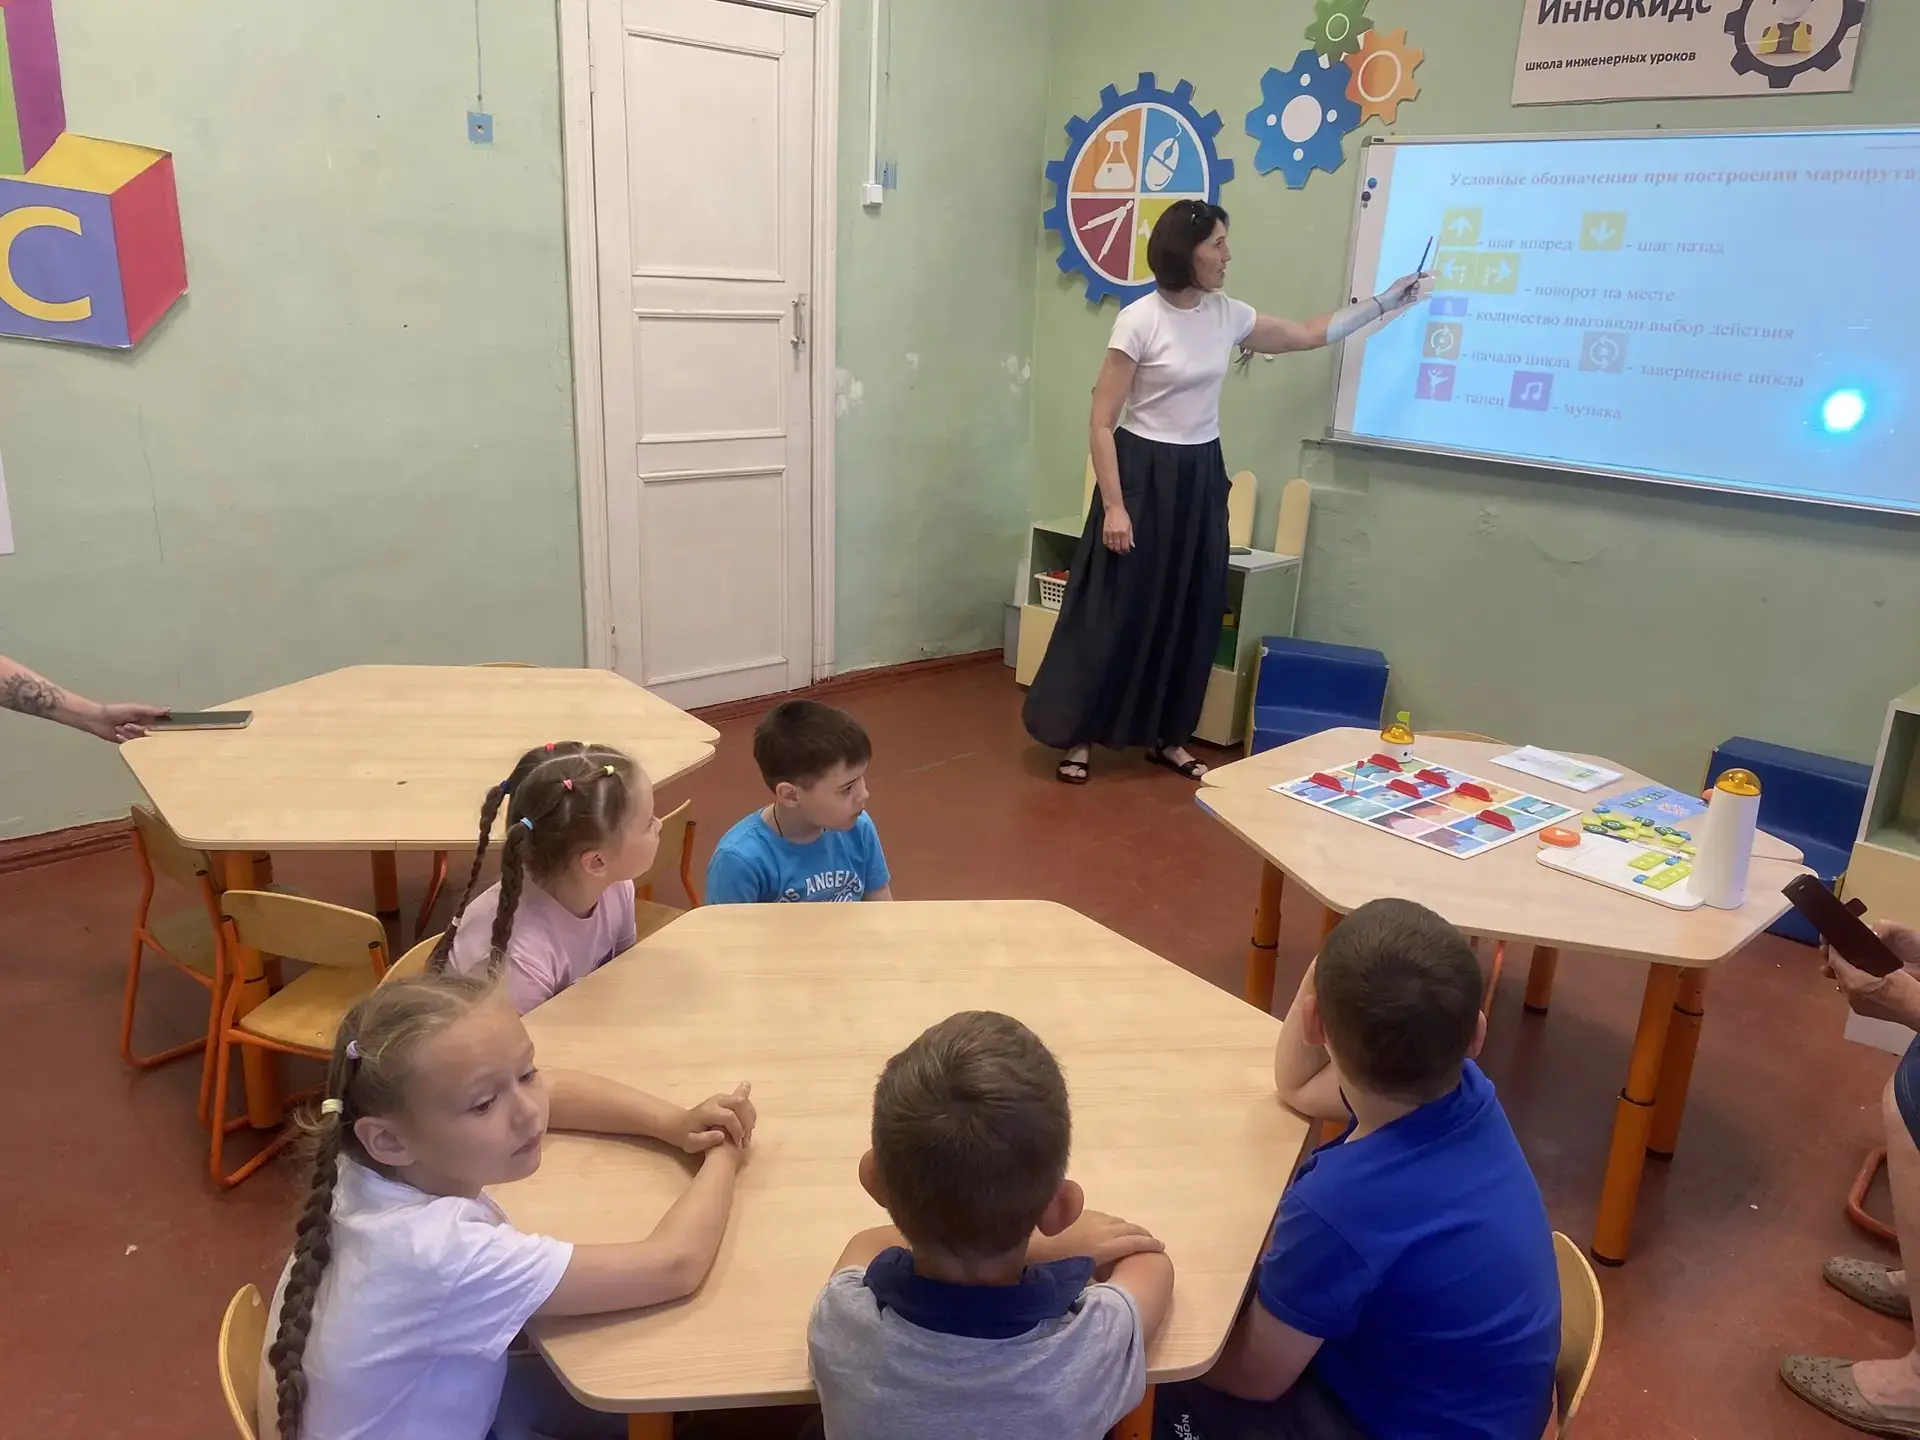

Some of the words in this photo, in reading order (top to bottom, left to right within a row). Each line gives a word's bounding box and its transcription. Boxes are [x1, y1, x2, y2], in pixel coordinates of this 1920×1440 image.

[1525, 59, 1563, 71] школа
[1565, 53, 1647, 69] инженерных
[1650, 51, 1697, 65] уроков
[1450, 172, 1527, 187] Условные
[1531, 170, 1637, 186] обозначения
[1644, 170, 1679, 186] при
[1684, 168, 1798, 186] построении
[1805, 167, 1916, 184] маршрута
[1488, 238, 1515, 249] шаг
[1638, 240, 1671, 252] шаг
[1676, 241, 1724, 254] назад
[1534, 286, 1600, 300] поворот
[1603, 288, 1621, 300] на
[1626, 289, 1675, 302] месте
[1476, 310, 1560, 326] количество
[1650, 319, 1704, 337] выбор
[1708, 322, 1795, 340] действия
[1471, 351, 1522, 365] начало
[1525, 354, 1570, 369] цикла
[1639, 364, 1743, 382] завершение
[1748, 373, 1804, 388] цикла
[1465, 393, 1505, 407] танец
[1564, 403, 1622, 420] музыка
